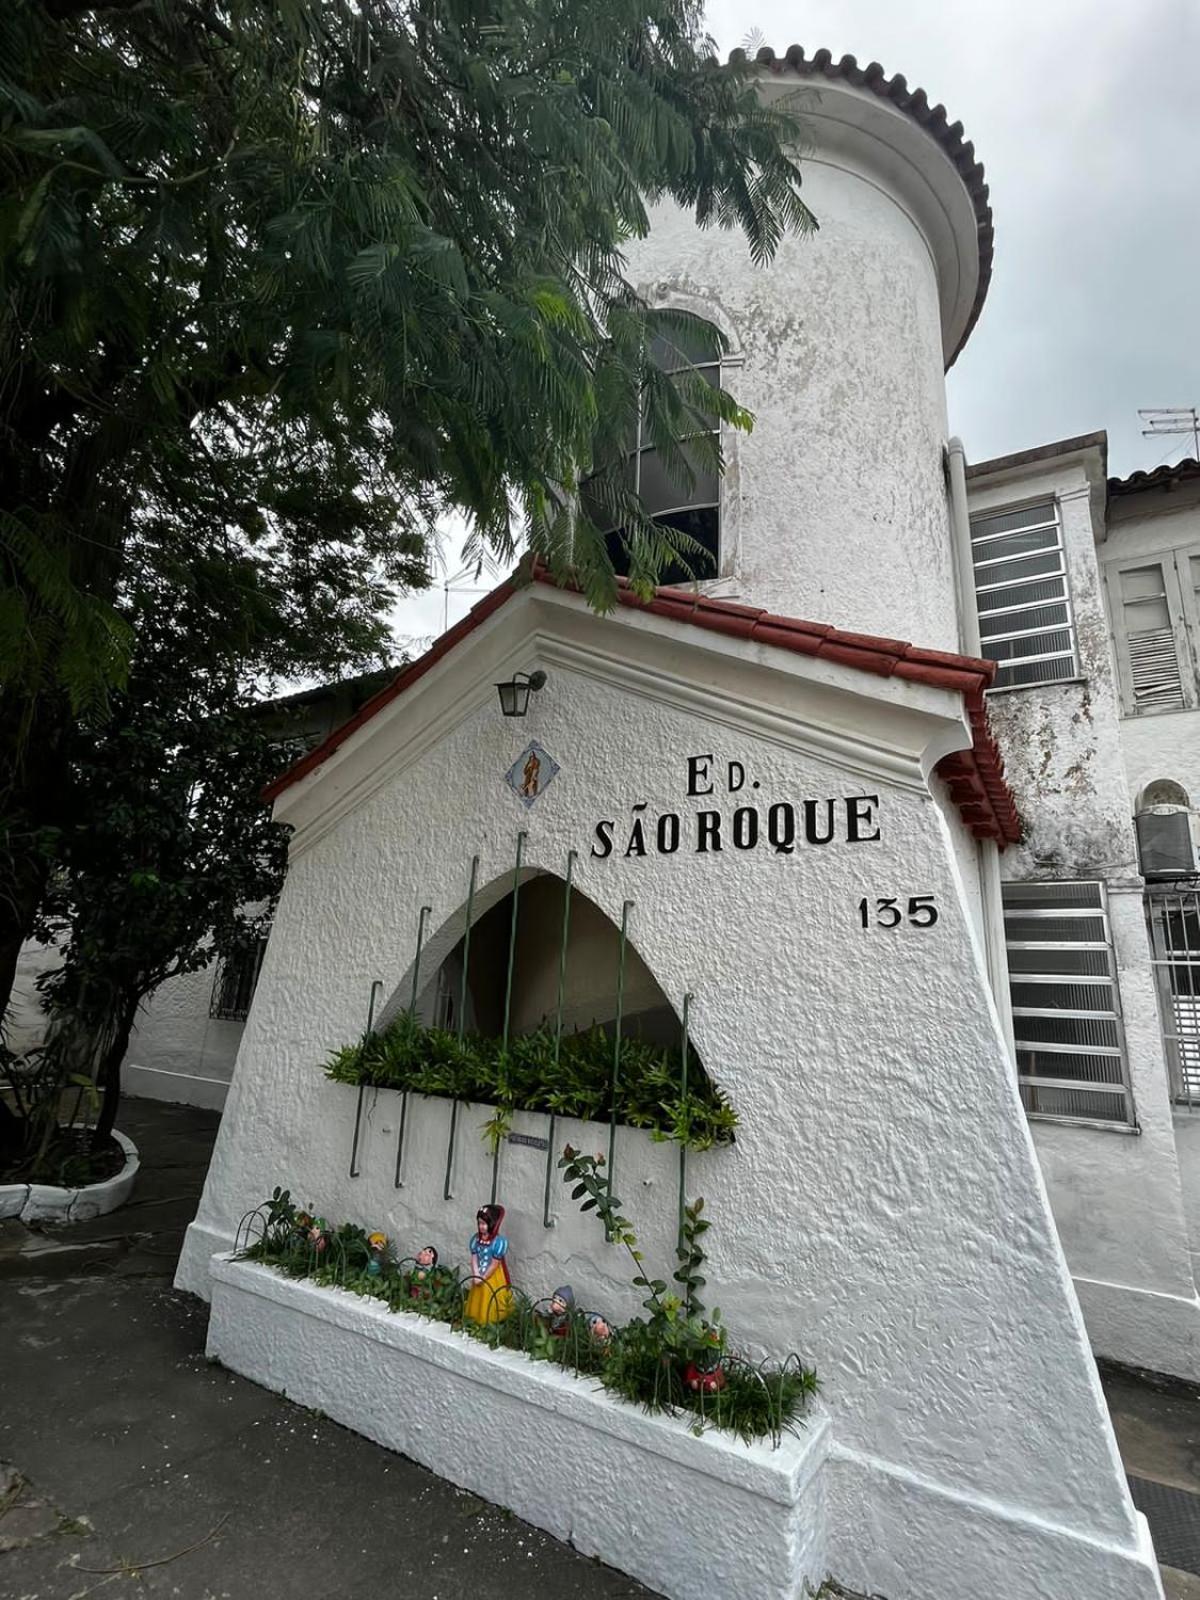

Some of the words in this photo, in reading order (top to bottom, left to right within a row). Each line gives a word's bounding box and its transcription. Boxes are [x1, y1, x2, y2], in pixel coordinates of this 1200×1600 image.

[687, 754, 760, 796] ED.
[590, 802, 680, 858] SÃO
[695, 795, 881, 854] ROQUE
[858, 896, 938, 928] 135
